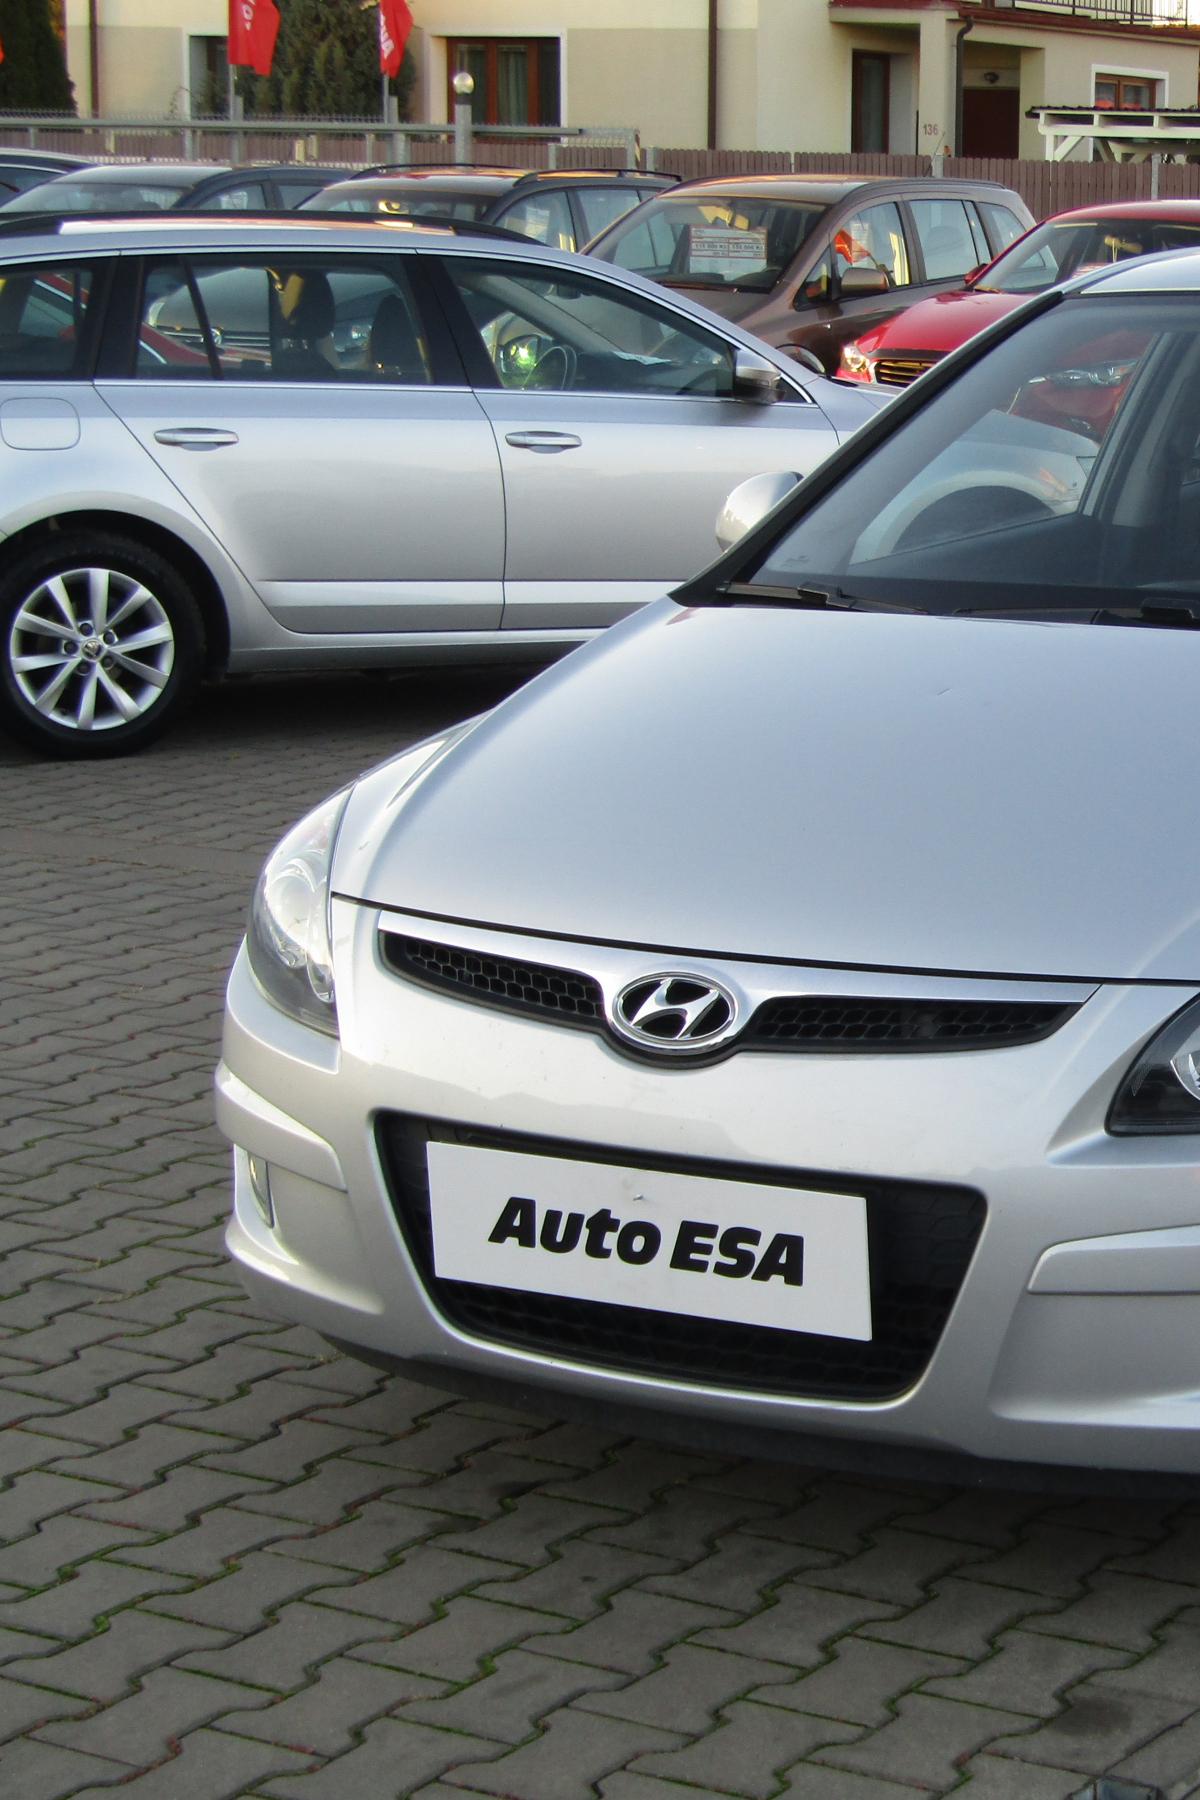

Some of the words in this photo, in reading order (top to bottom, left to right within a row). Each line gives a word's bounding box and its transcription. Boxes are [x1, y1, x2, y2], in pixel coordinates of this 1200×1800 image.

[923, 123, 938, 136] 136
[488, 1196, 662, 1265] Auto
[669, 1219, 804, 1287] ESA
